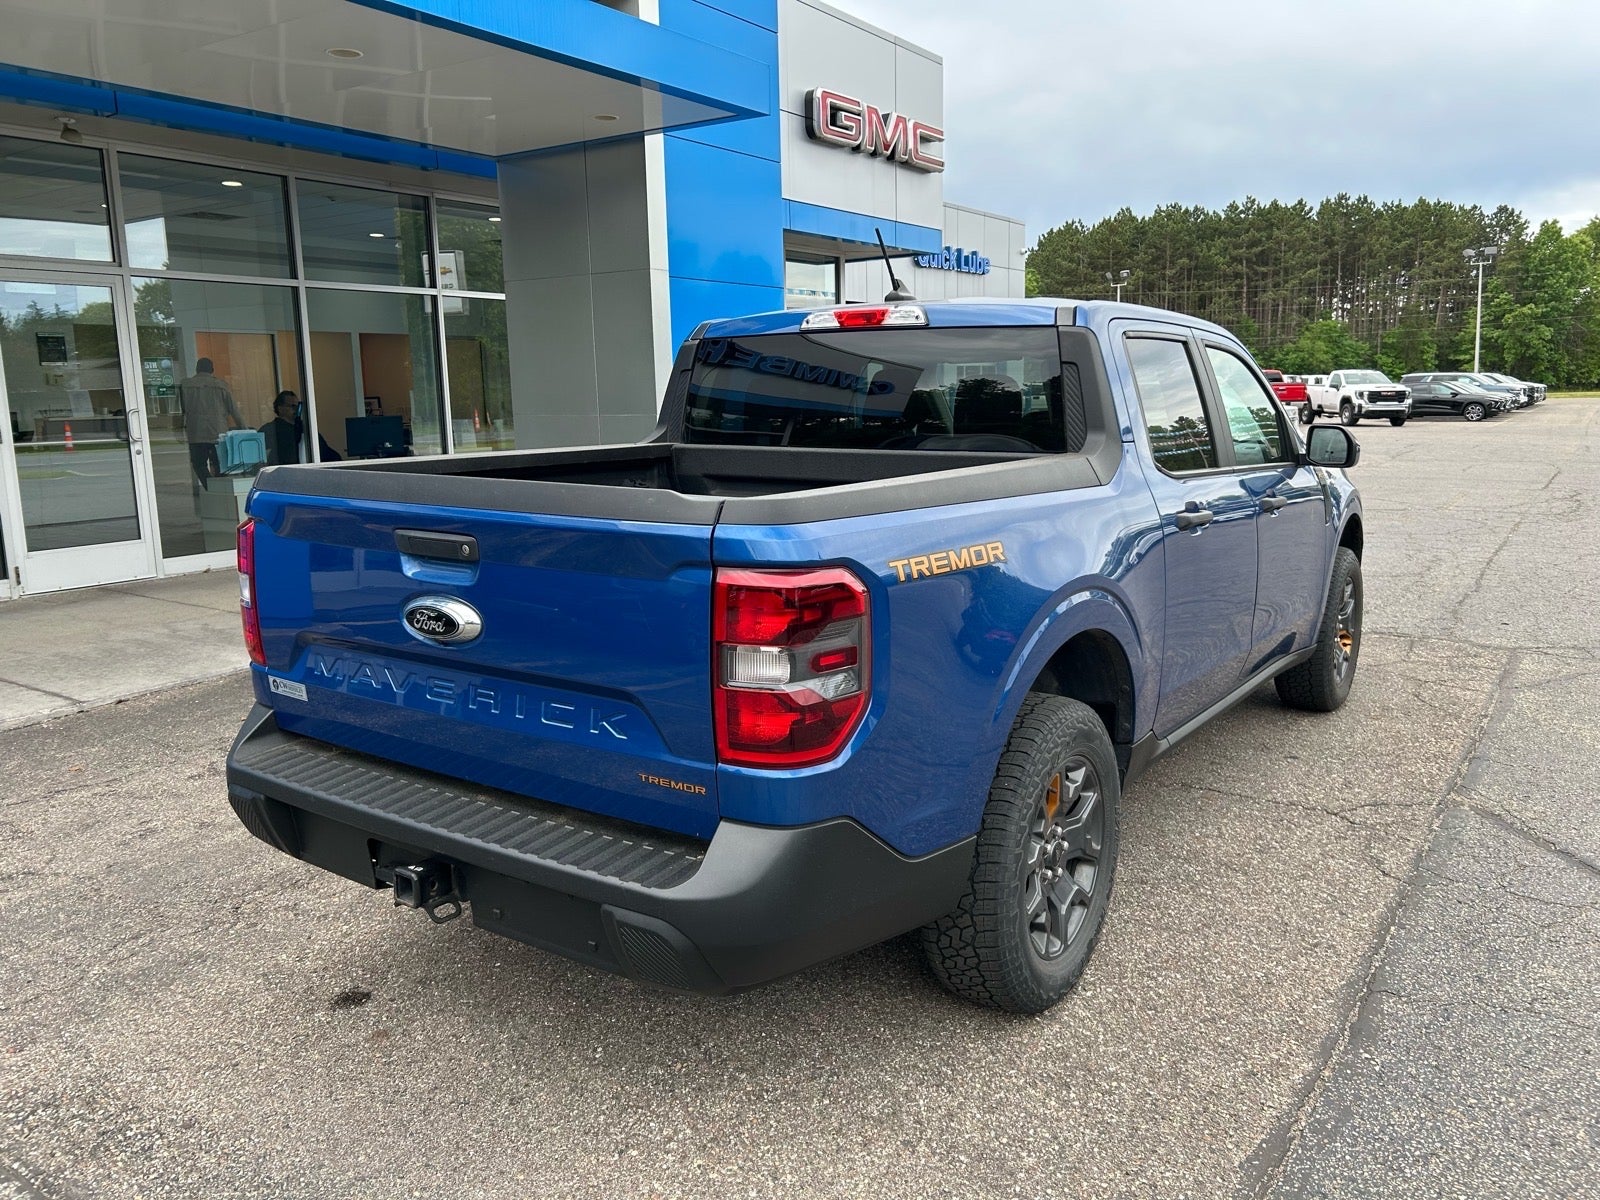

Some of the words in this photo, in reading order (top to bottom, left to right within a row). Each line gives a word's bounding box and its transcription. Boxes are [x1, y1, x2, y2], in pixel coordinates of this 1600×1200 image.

[806, 87, 945, 173] GMC
[917, 249, 958, 271] Quick
[960, 249, 991, 274] Lube
[888, 541, 1007, 582] TREMOR
[412, 609, 446, 633] Ford
[314, 654, 628, 740] MAVERICK
[638, 772, 707, 796] TREMOR
